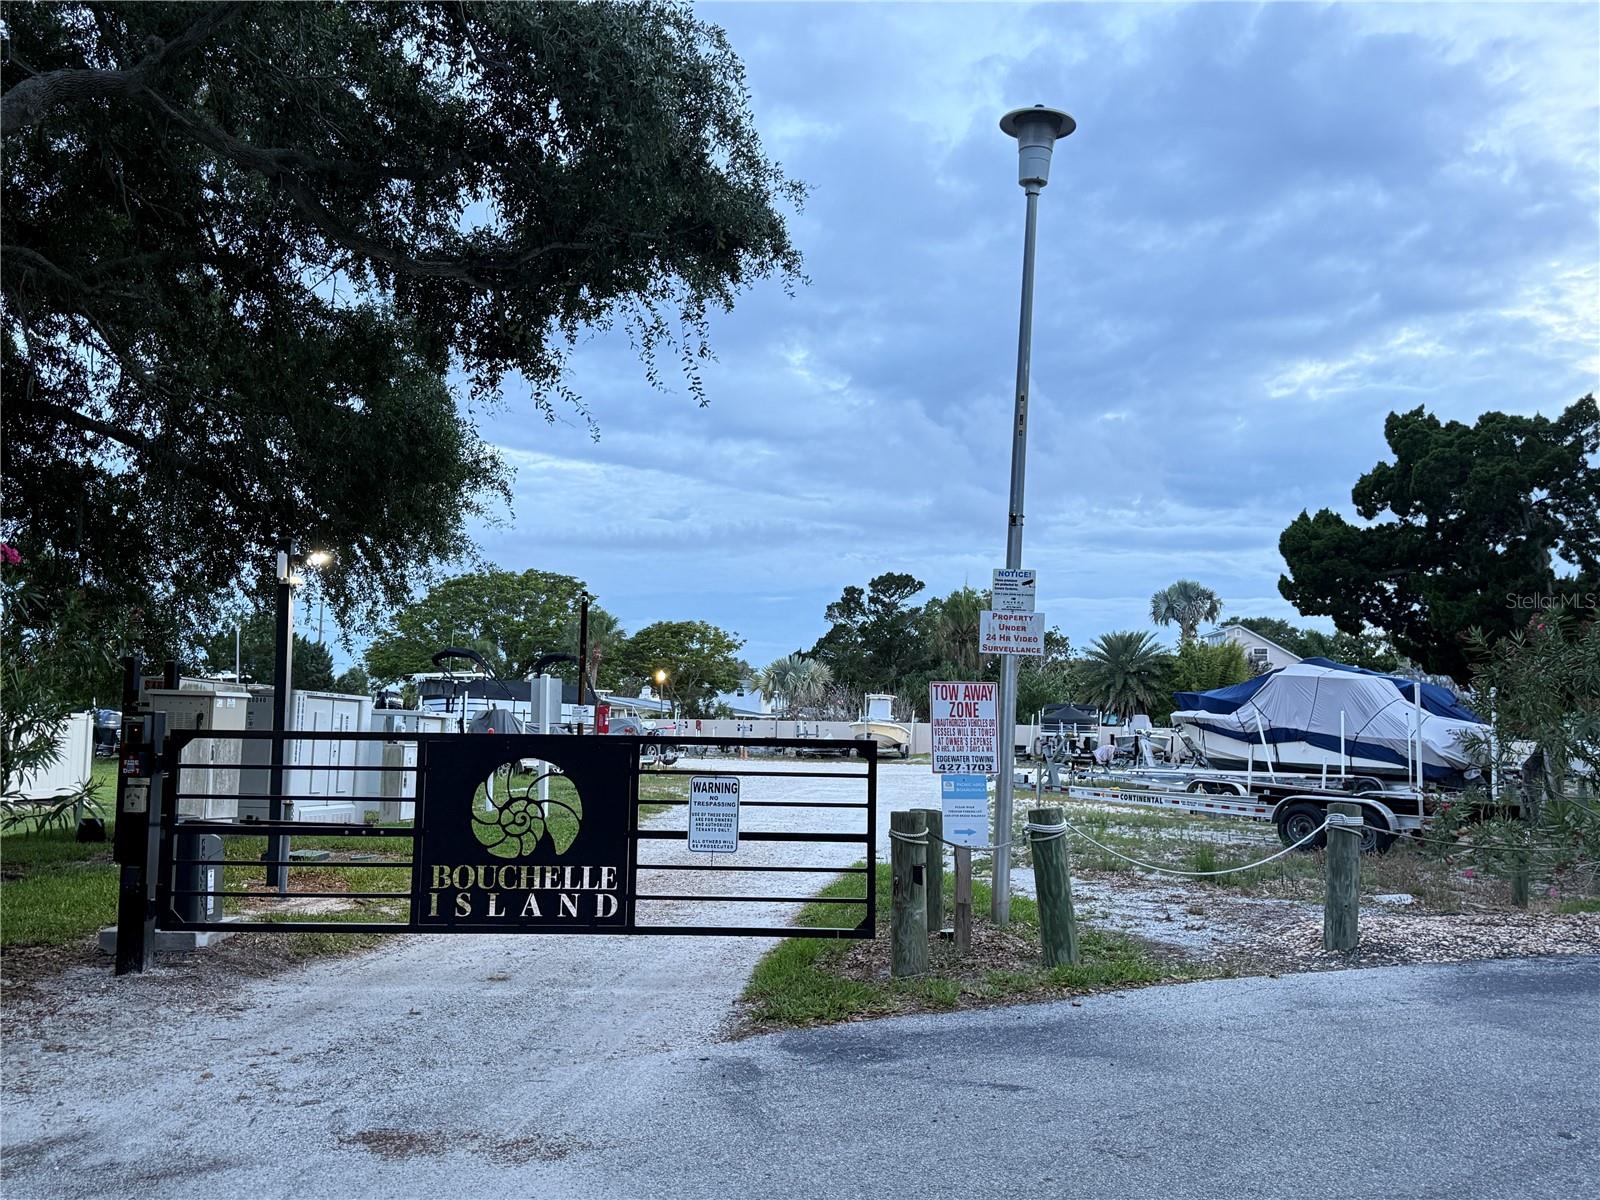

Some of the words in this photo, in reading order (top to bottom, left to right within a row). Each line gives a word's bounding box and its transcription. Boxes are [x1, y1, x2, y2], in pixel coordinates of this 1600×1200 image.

[998, 570, 1032, 578] NOTICE!
[992, 612, 1034, 622] PROPERTY
[998, 624, 1027, 632] UNDER
[986, 633, 996, 641] 24
[999, 634, 1011, 642] HR
[1014, 634, 1039, 643] VIDEO
[982, 644, 1041, 654] SURVEILLANCE
[933, 684, 959, 701] TOW
[963, 684, 994, 702] AWAY
[949, 702, 980, 718] ZONE
[934, 718, 968, 727] UNAUTHORIZED
[968, 719, 988, 728] VEHICLES
[988, 719, 996, 728] OR
[934, 728, 956, 736] VESSELS
[957, 728, 969, 736] WILL
[970, 728, 977, 736] BE
[978, 728, 996, 736] TOWED
[938, 736, 944, 746] AT
[946, 736, 968, 746] OWNER'S
[970, 737, 993, 746] EXPENSE
[936, 755, 970, 763] EDGEWATER
[972, 755, 994, 763] TOWING
[693, 782, 738, 794] WARNING
[1120, 793, 1164, 804] CONTINENTAL
[429, 864, 618, 891] BOUCHELLE
[428, 892, 619, 918] ISLAND
